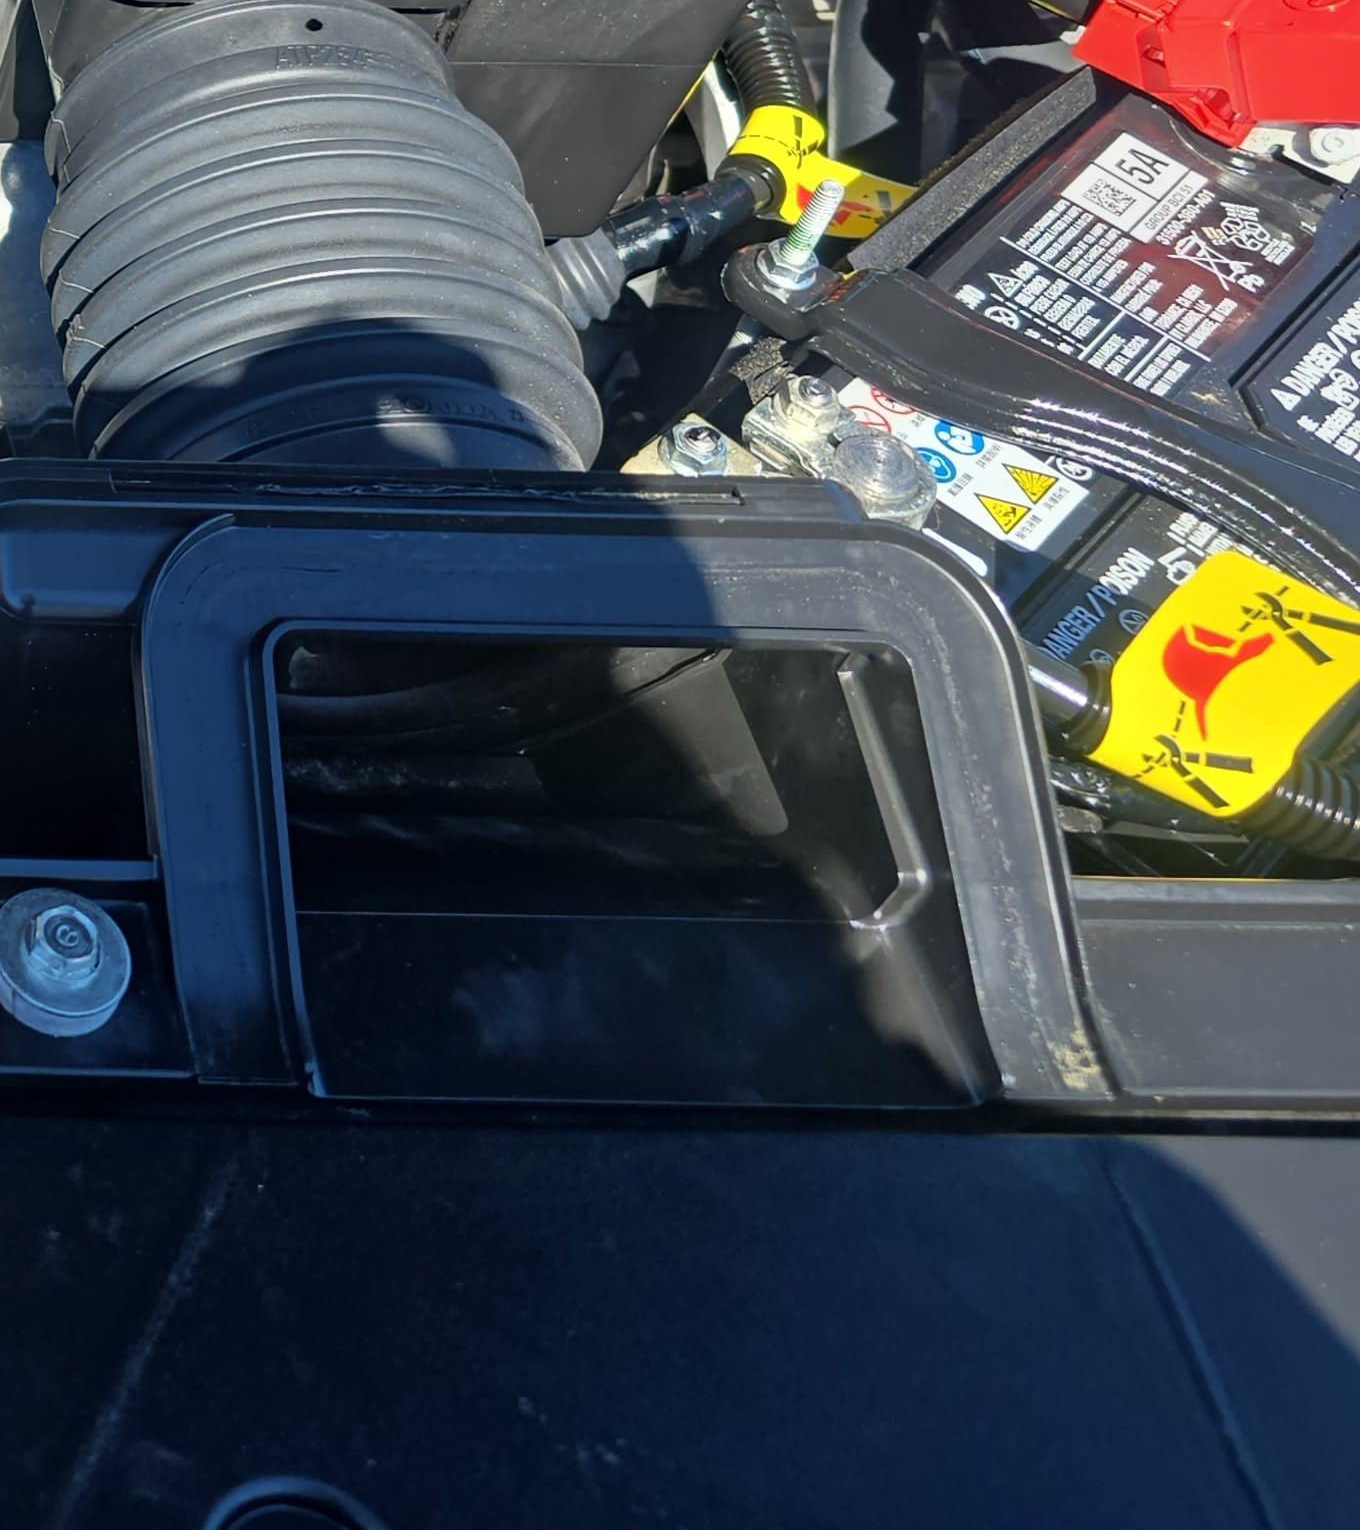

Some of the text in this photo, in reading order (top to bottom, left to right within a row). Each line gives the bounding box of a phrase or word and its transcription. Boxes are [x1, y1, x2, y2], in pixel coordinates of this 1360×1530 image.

[1112, 145, 1170, 186] 5A
[1142, 183, 1195, 231] GROUP BCI 51
[1064, 245, 1084, 261] LOAD
